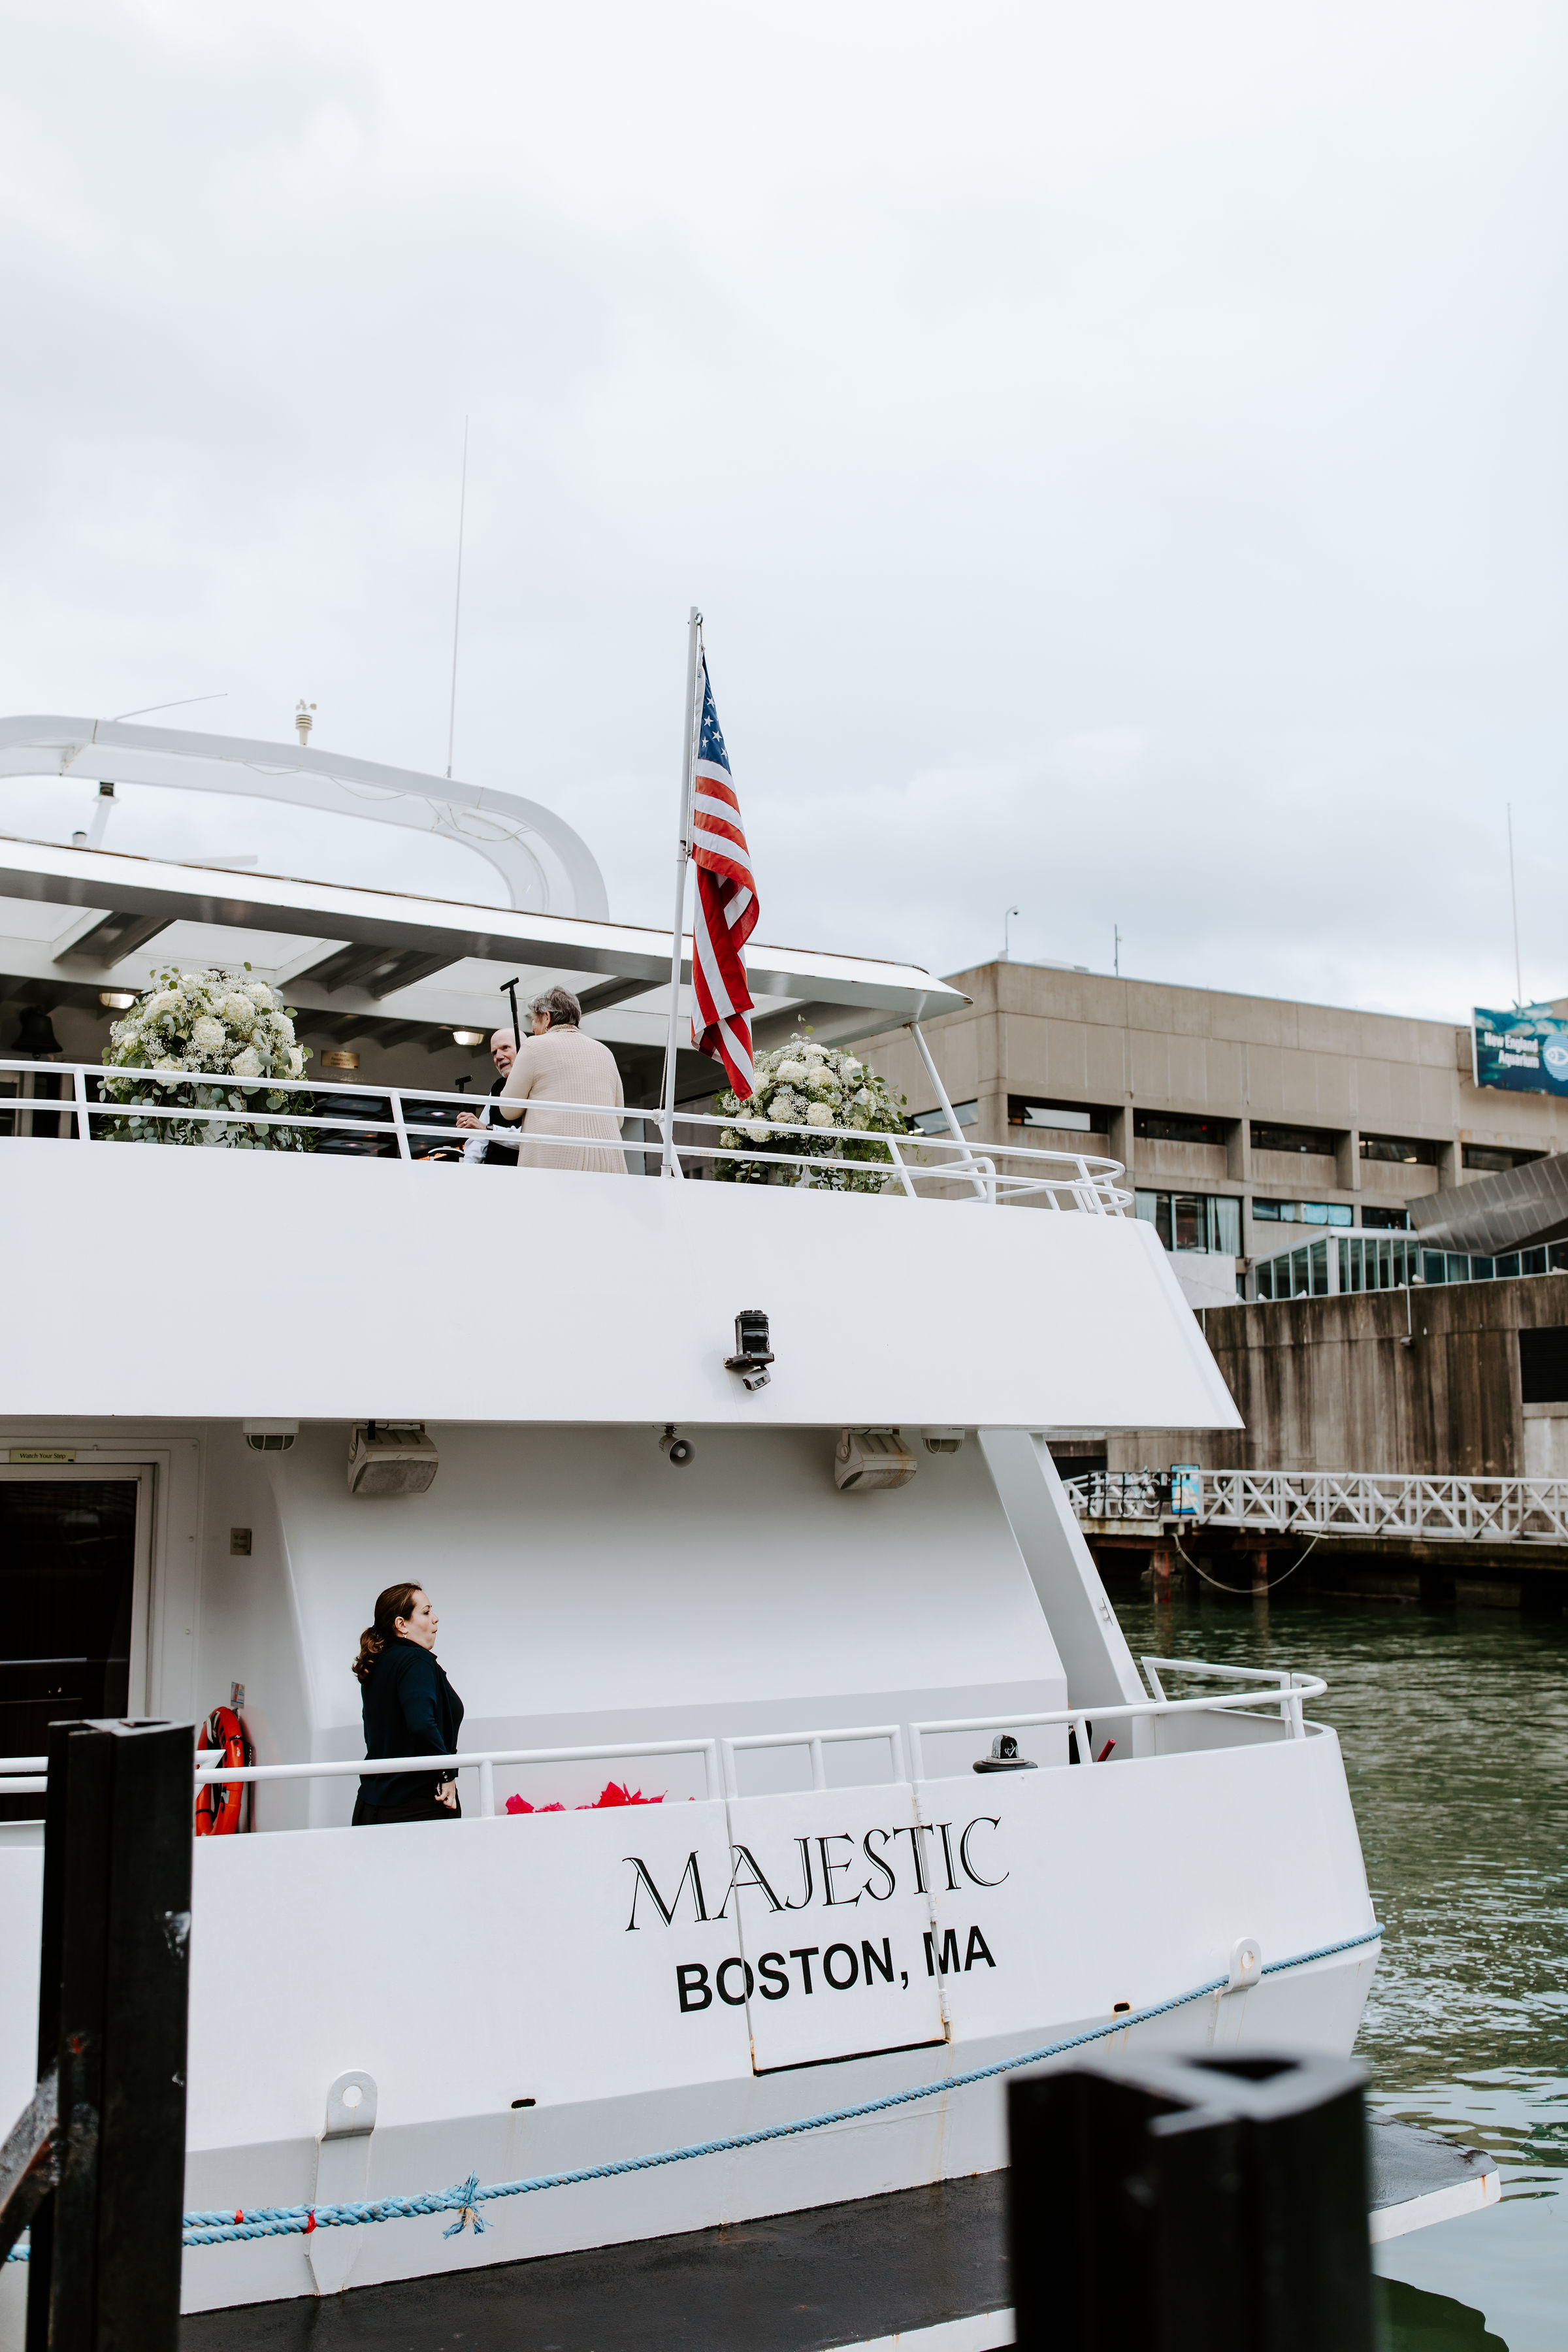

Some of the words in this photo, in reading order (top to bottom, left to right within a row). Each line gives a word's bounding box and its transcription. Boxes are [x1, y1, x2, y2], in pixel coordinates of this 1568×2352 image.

[1484, 1032, 1505, 1048] New
[1505, 1034, 1539, 1053] England
[1498, 1050, 1539, 1069] Aquarium
[622, 1817, 1009, 1932] MAJESTIC
[676, 1937, 909, 2013] BOSTON,
[923, 1925, 997, 1977] MA
